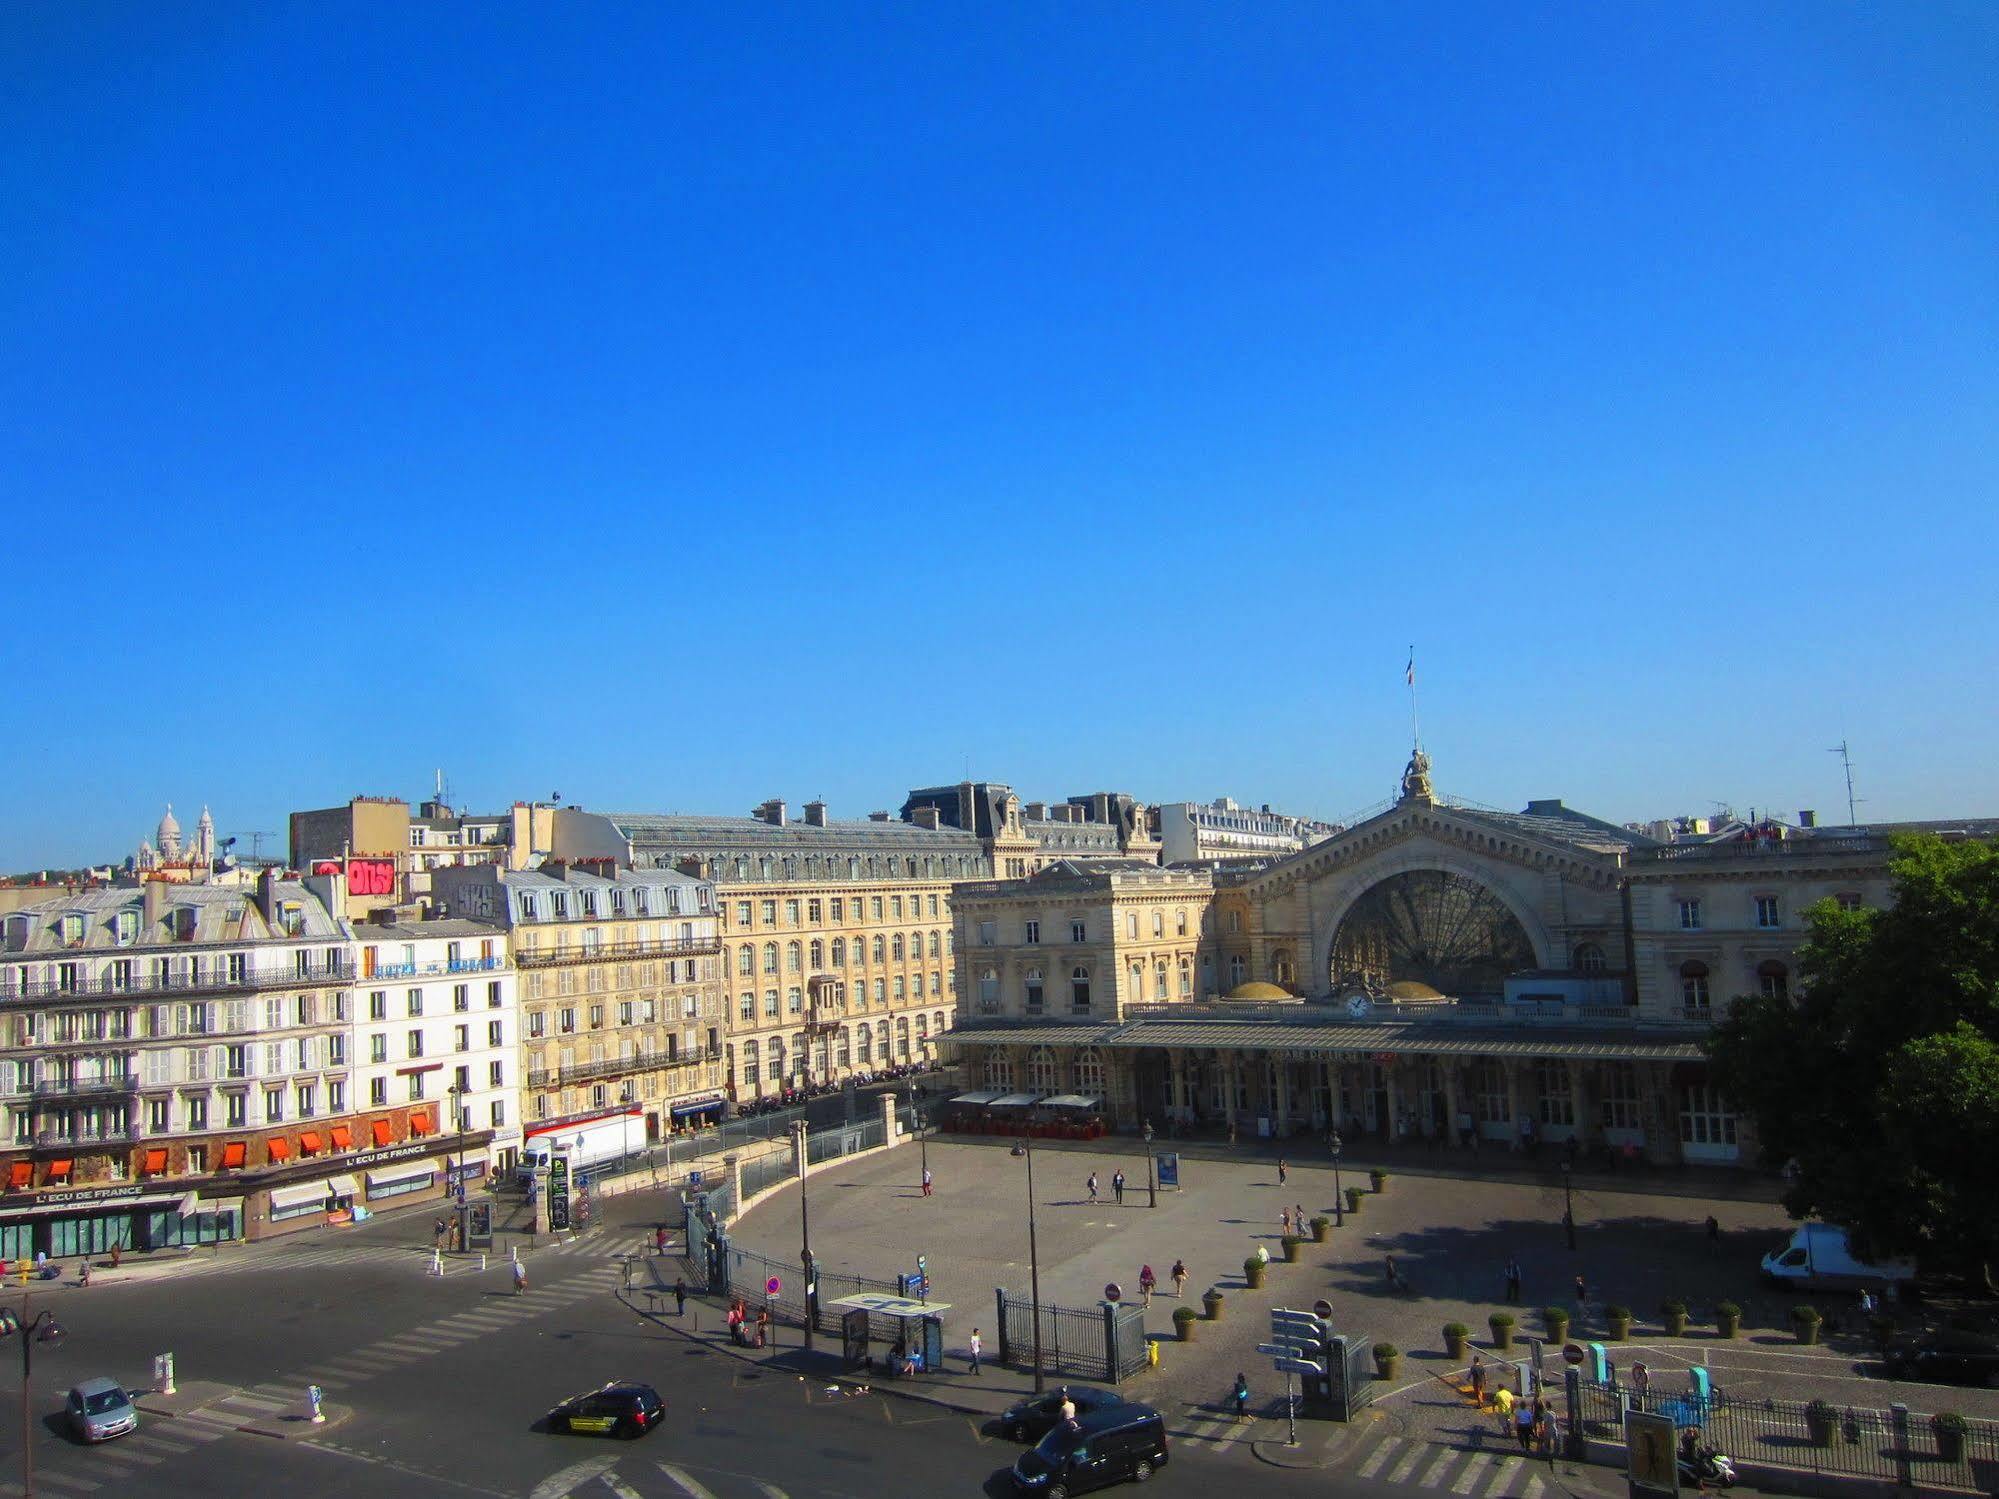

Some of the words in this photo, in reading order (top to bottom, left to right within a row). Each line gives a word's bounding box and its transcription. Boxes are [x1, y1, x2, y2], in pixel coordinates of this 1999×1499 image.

[376, 1151, 390, 1160] DE
[390, 1144, 427, 1159] FRANCE
[75, 1190, 93, 1200] DE
[94, 1185, 144, 1198] FRANCE
